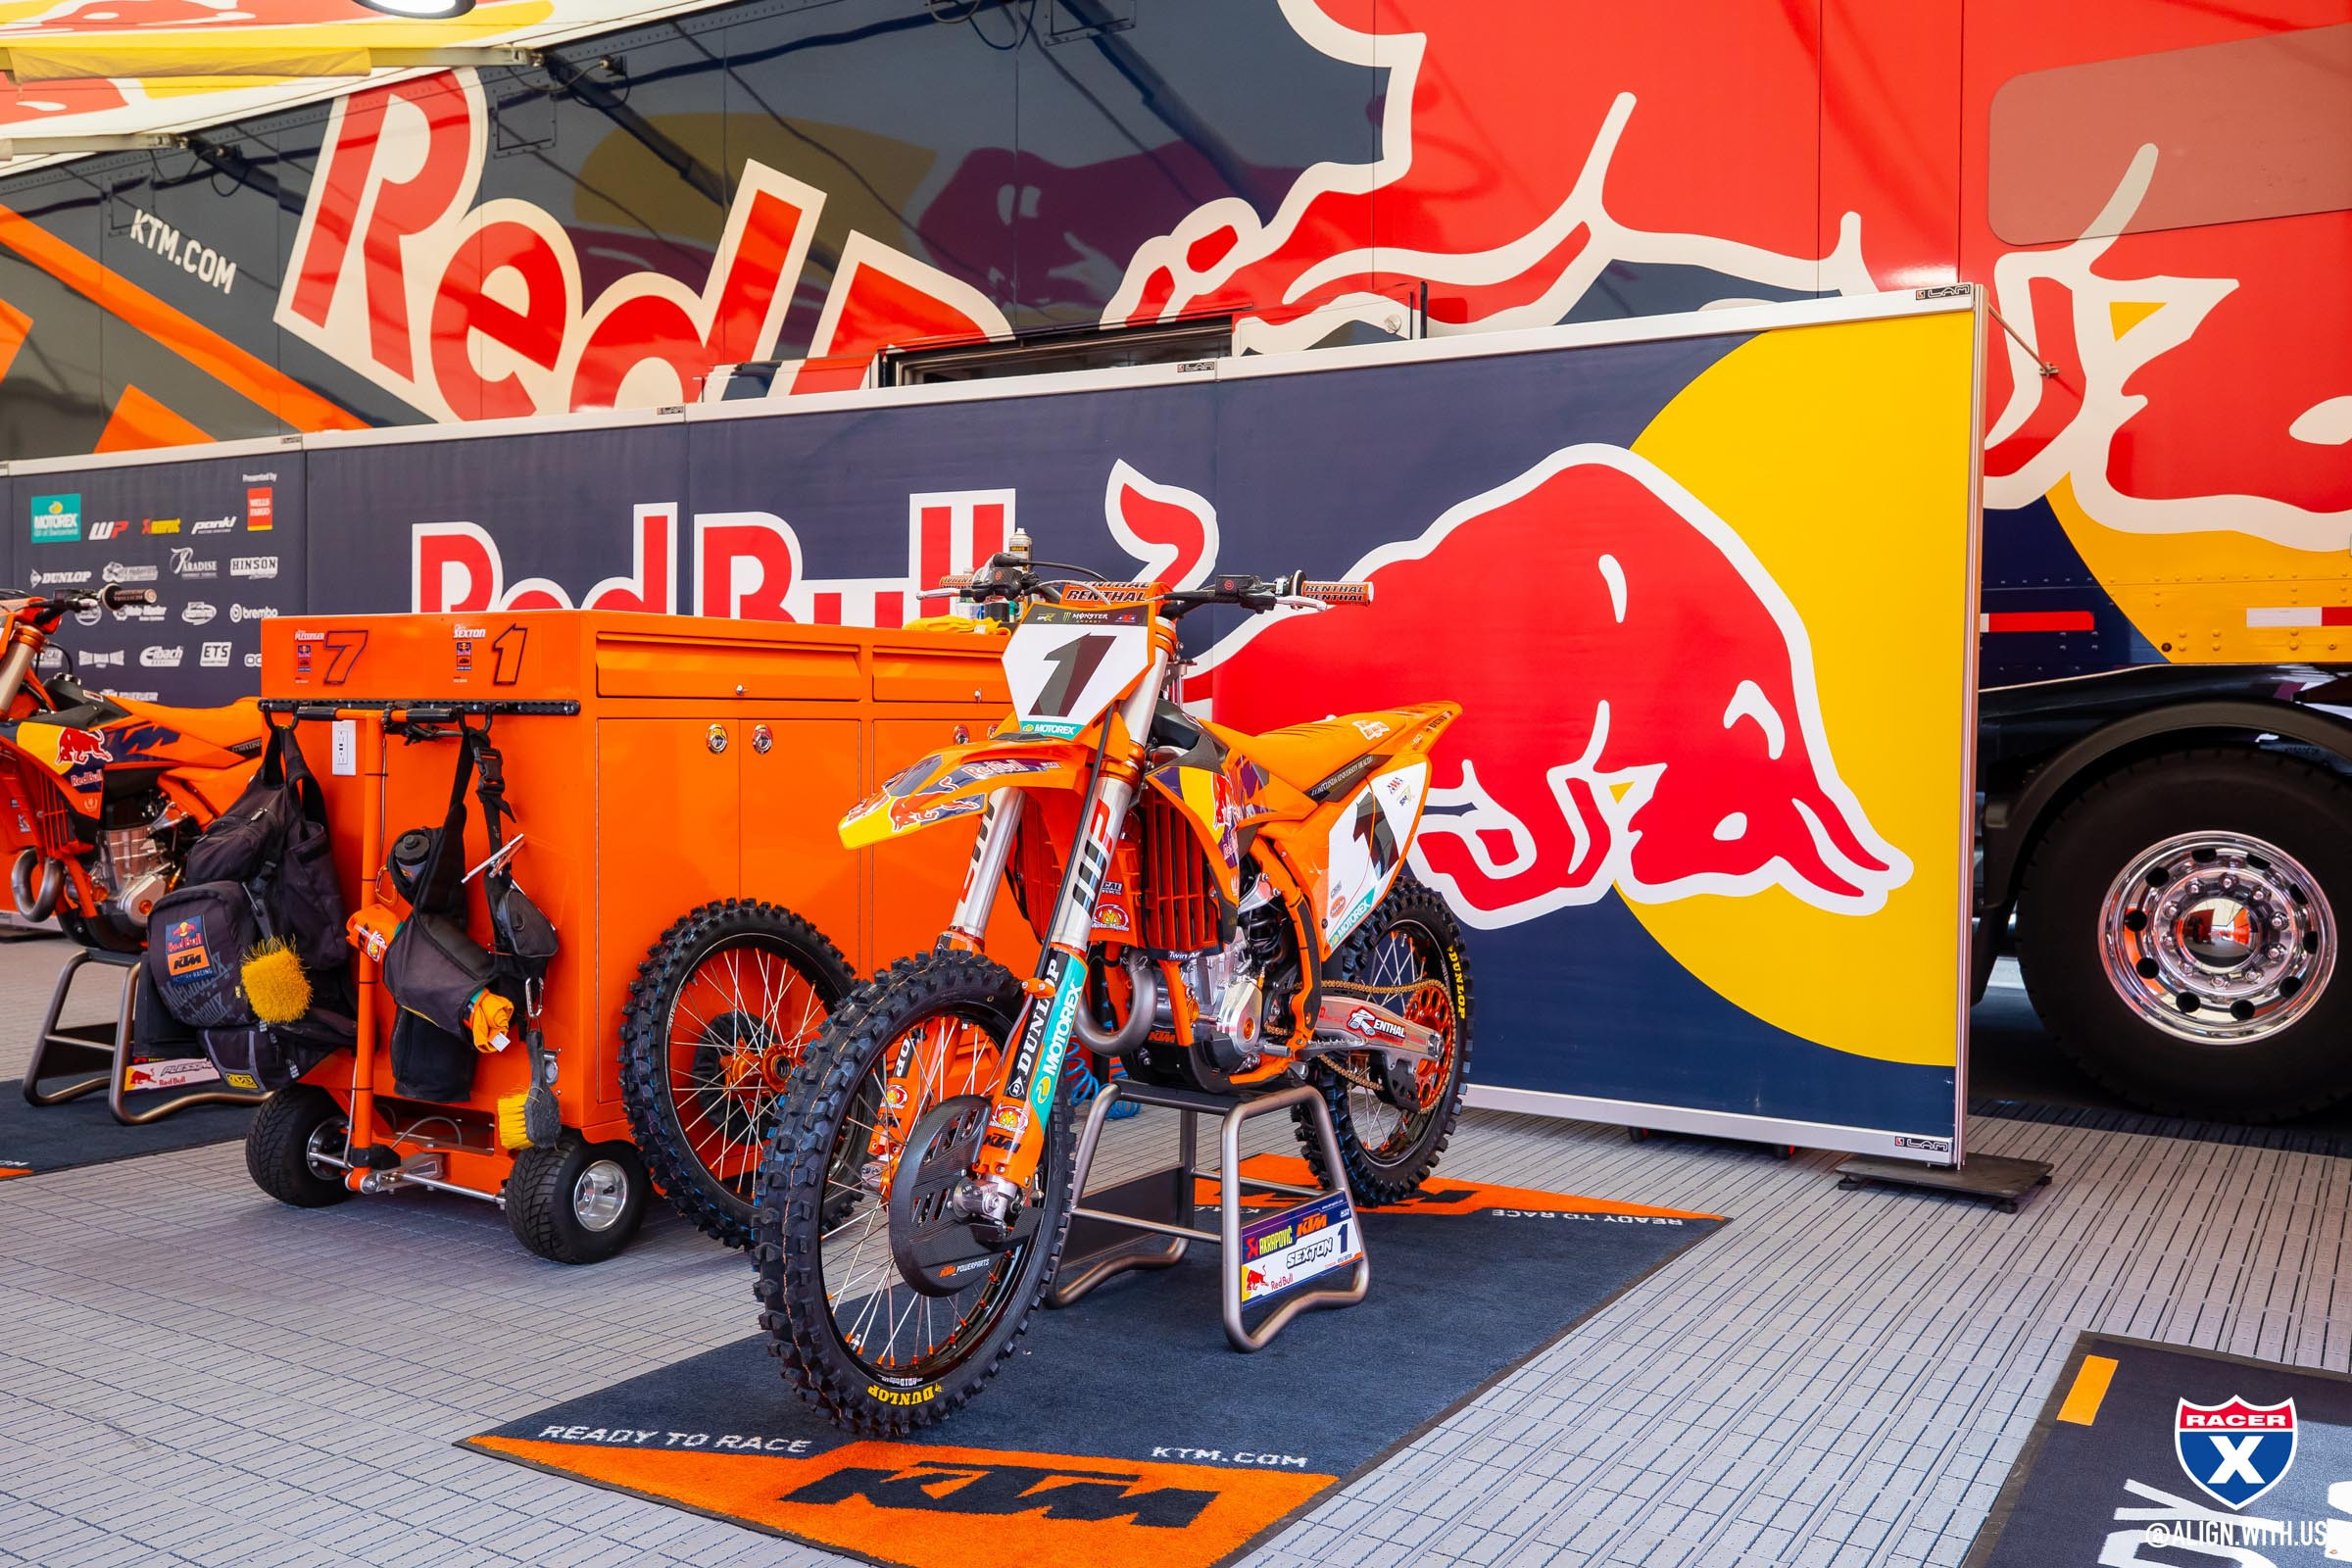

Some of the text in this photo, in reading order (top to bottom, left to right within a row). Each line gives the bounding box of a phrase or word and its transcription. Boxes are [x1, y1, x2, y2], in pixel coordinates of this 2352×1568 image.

[130, 209, 237, 294] KTM.COM
[34, 514, 78, 529] MOTOREX
[88, 520, 129, 540] WP
[232, 558, 276, 570] HINSON
[42, 570, 92, 584] DUNLOP
[1065, 590, 1146, 603] RENTHAL
[242, 607, 278, 619] brembo
[454, 628, 486, 639] SEXTON
[204, 646, 228, 658] ETS
[323, 630, 368, 685] 7
[492, 623, 528, 685] 1
[1028, 632, 1117, 717] 1
[1034, 723, 1076, 735] MOTOREX
[1338, 899, 1371, 938] MOTOREX
[168, 932, 202, 952] Red Bull
[173, 953, 202, 970] KTM
[1169, 951, 1202, 960] Twin Air
[192, 968, 213, 978] RACING
[1447, 951, 1467, 1020] DUNLOP
[1044, 980, 1084, 1077] MOTOREX
[1148, 1031, 1176, 1044] KTM
[983, 1132, 1021, 1154] KTM
[1492, 1208, 1555, 1219] RACE
[1602, 1213, 1684, 1226] READY
[1296, 1212, 1328, 1238] KTM
[1286, 1222, 1348, 1270] SEXTON 1
[956, 1258, 990, 1273] POWERPARTS
[1270, 1273, 1294, 1292] Red Bull
[866, 1384, 935, 1406] DUNLOP
[538, 1424, 813, 1453] READY TO RACE
[1152, 1446, 1309, 1469] KTM.COM
[777, 1460, 1221, 1530] KTM
